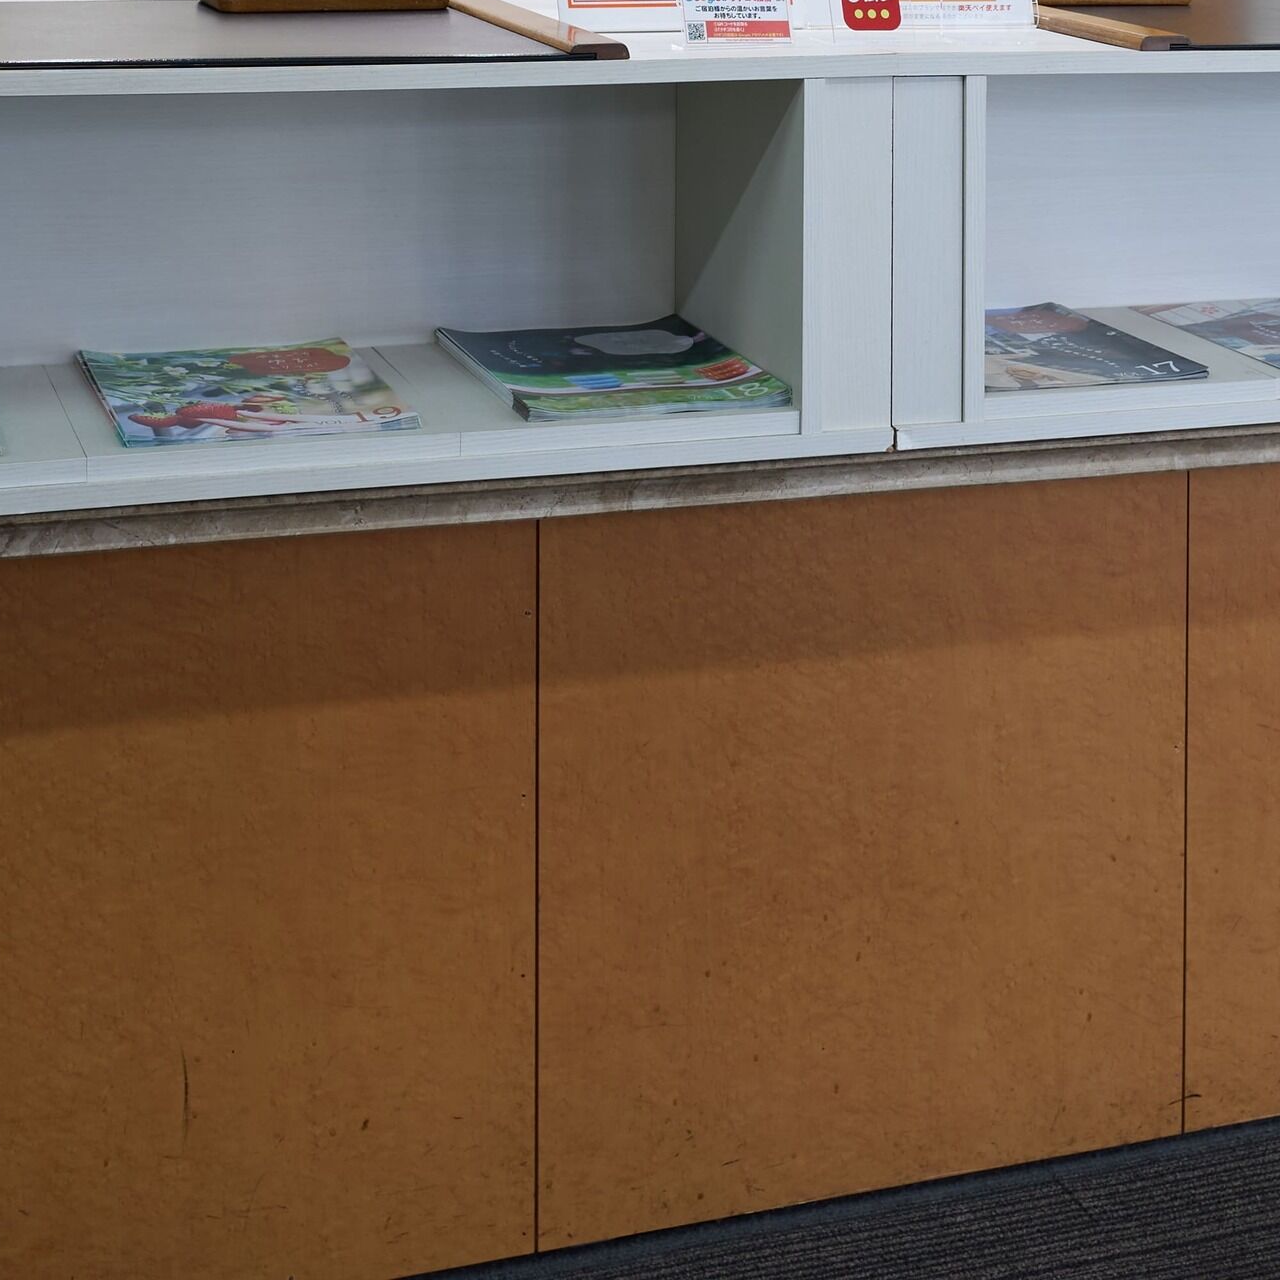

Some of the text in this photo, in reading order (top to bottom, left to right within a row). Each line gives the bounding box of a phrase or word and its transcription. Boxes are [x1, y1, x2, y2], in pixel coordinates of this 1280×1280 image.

[1134, 360, 1181, 376] 17
[720, 382, 769, 400] 18
[354, 406, 402, 423] 19
